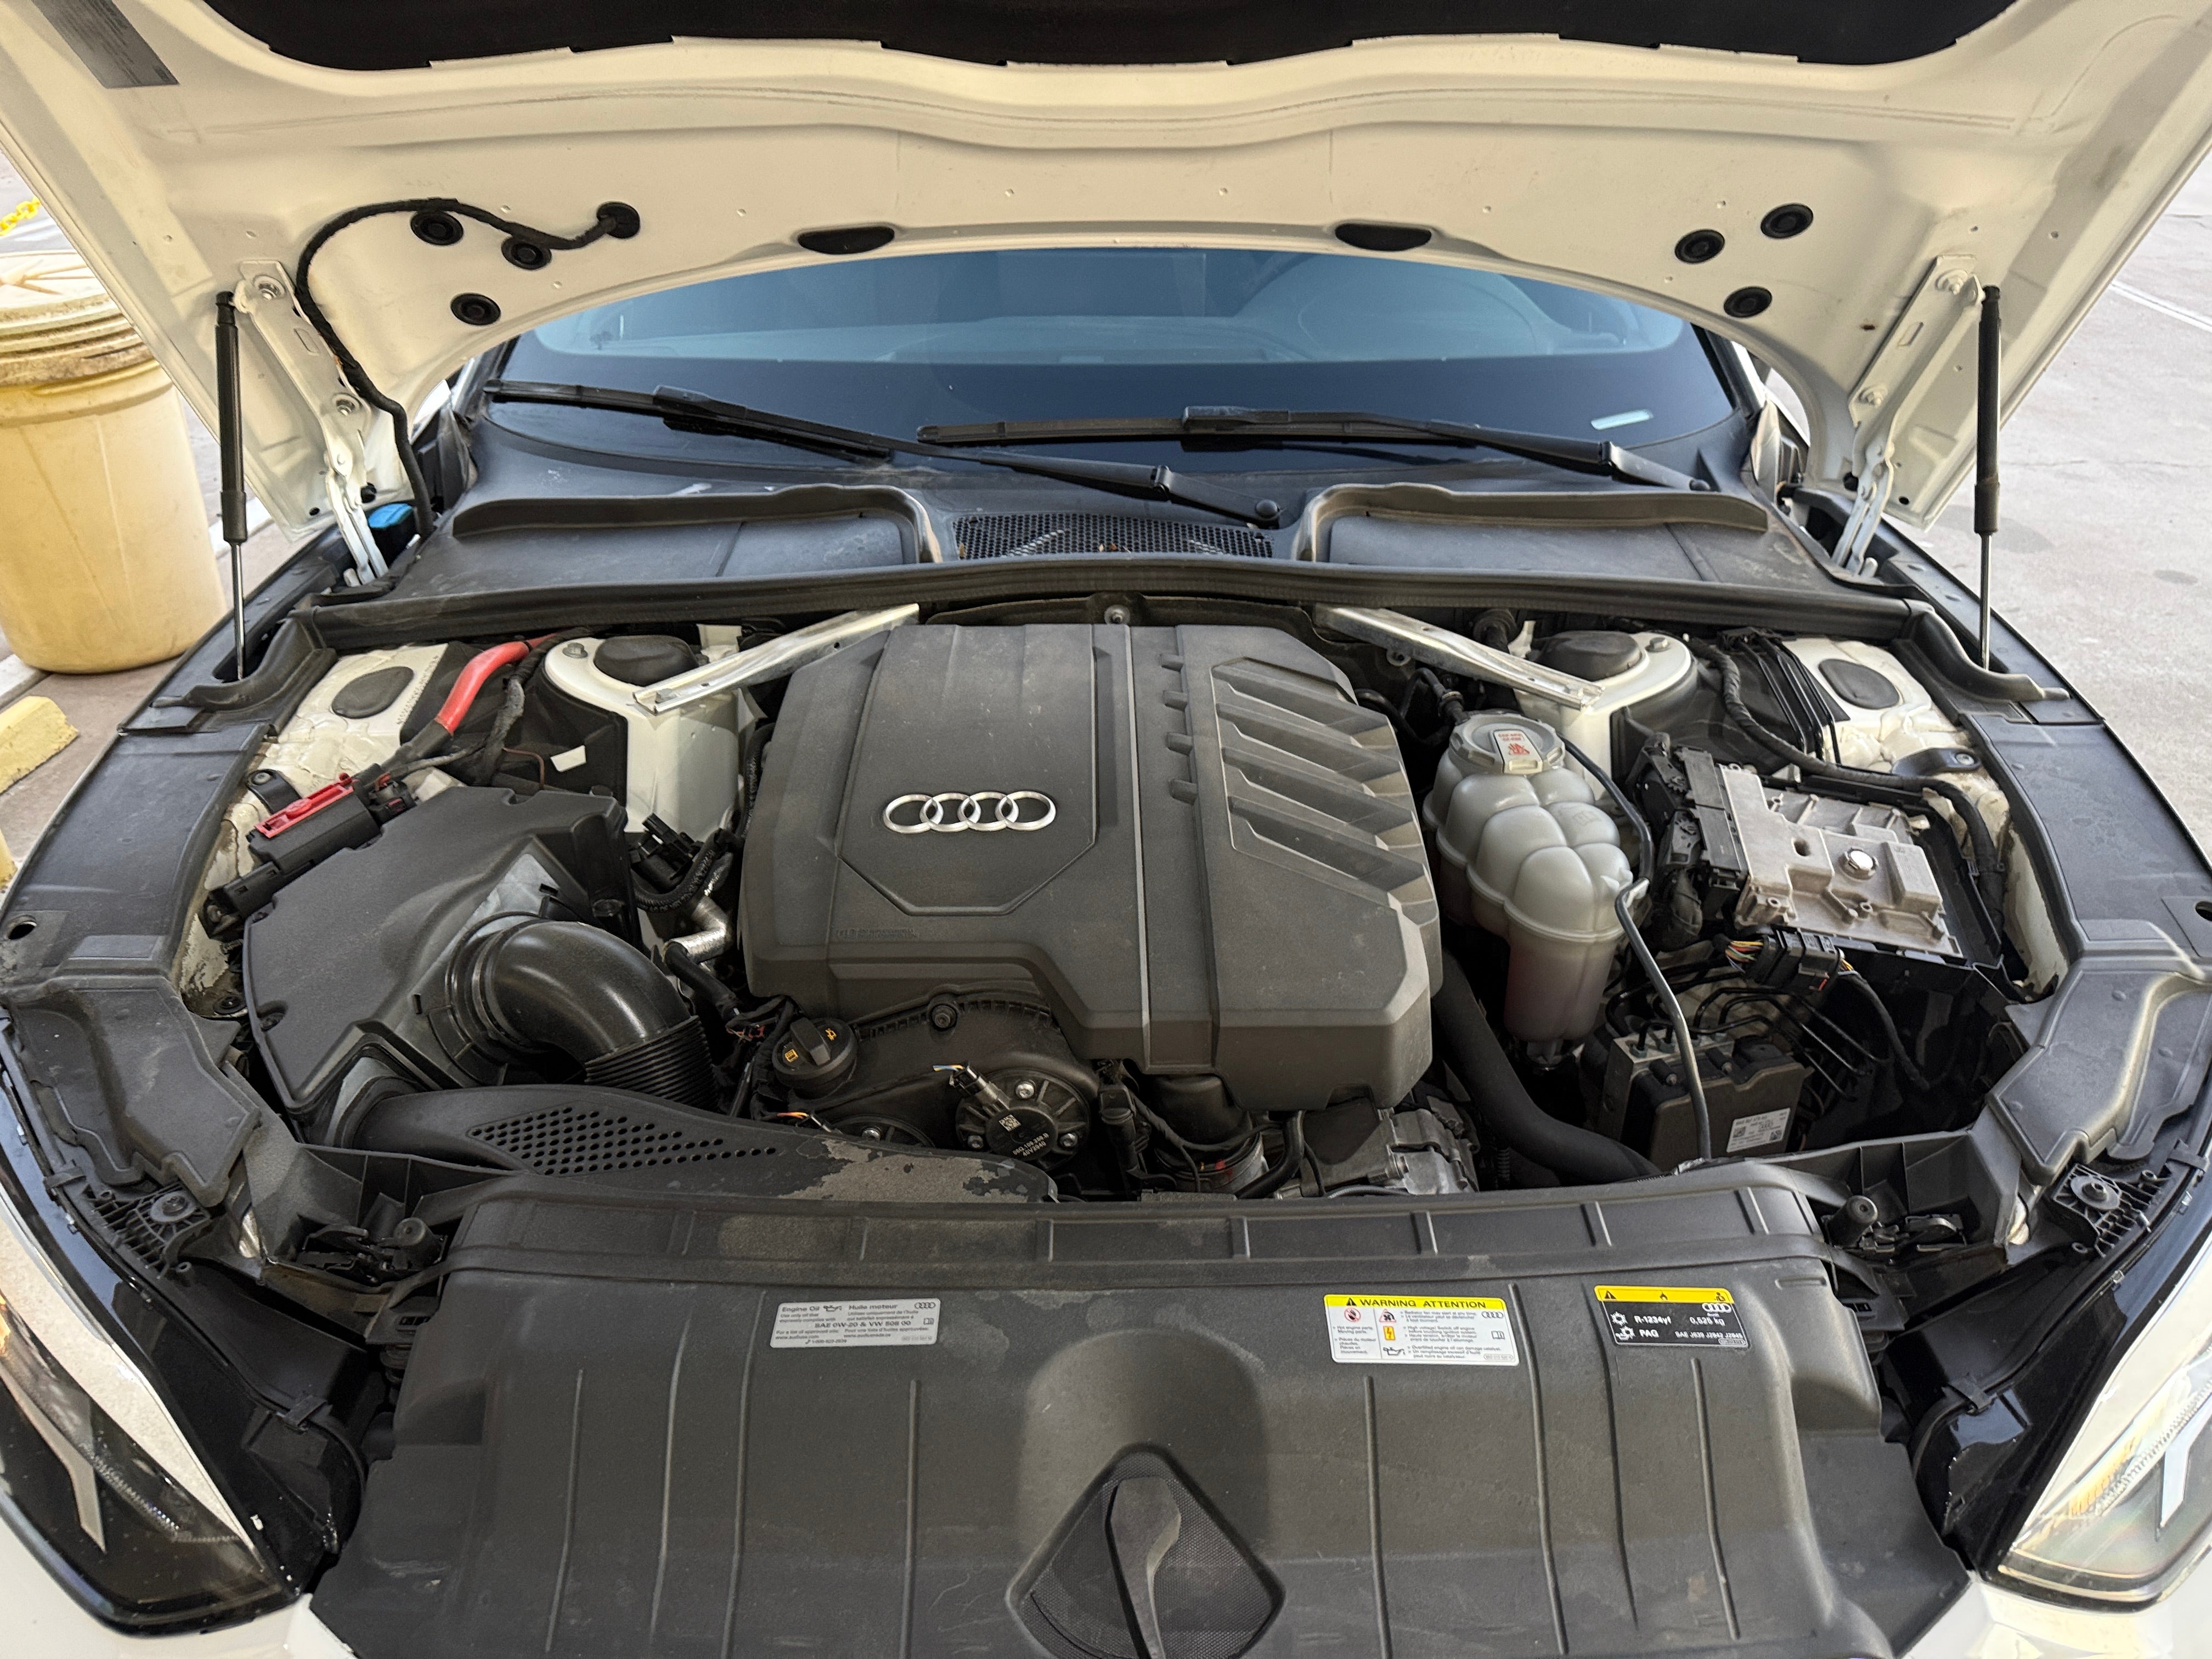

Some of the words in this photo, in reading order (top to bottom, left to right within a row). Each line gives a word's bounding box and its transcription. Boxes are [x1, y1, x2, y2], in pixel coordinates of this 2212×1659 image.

[1359, 1299, 1417, 1307] WARNING
[1423, 1300, 1486, 1309] ATTENTION
[1634, 1315, 1672, 1325] R-1234yf
[1713, 1317, 1725, 1327] kg
[1639, 1329, 1660, 1338] PAG
